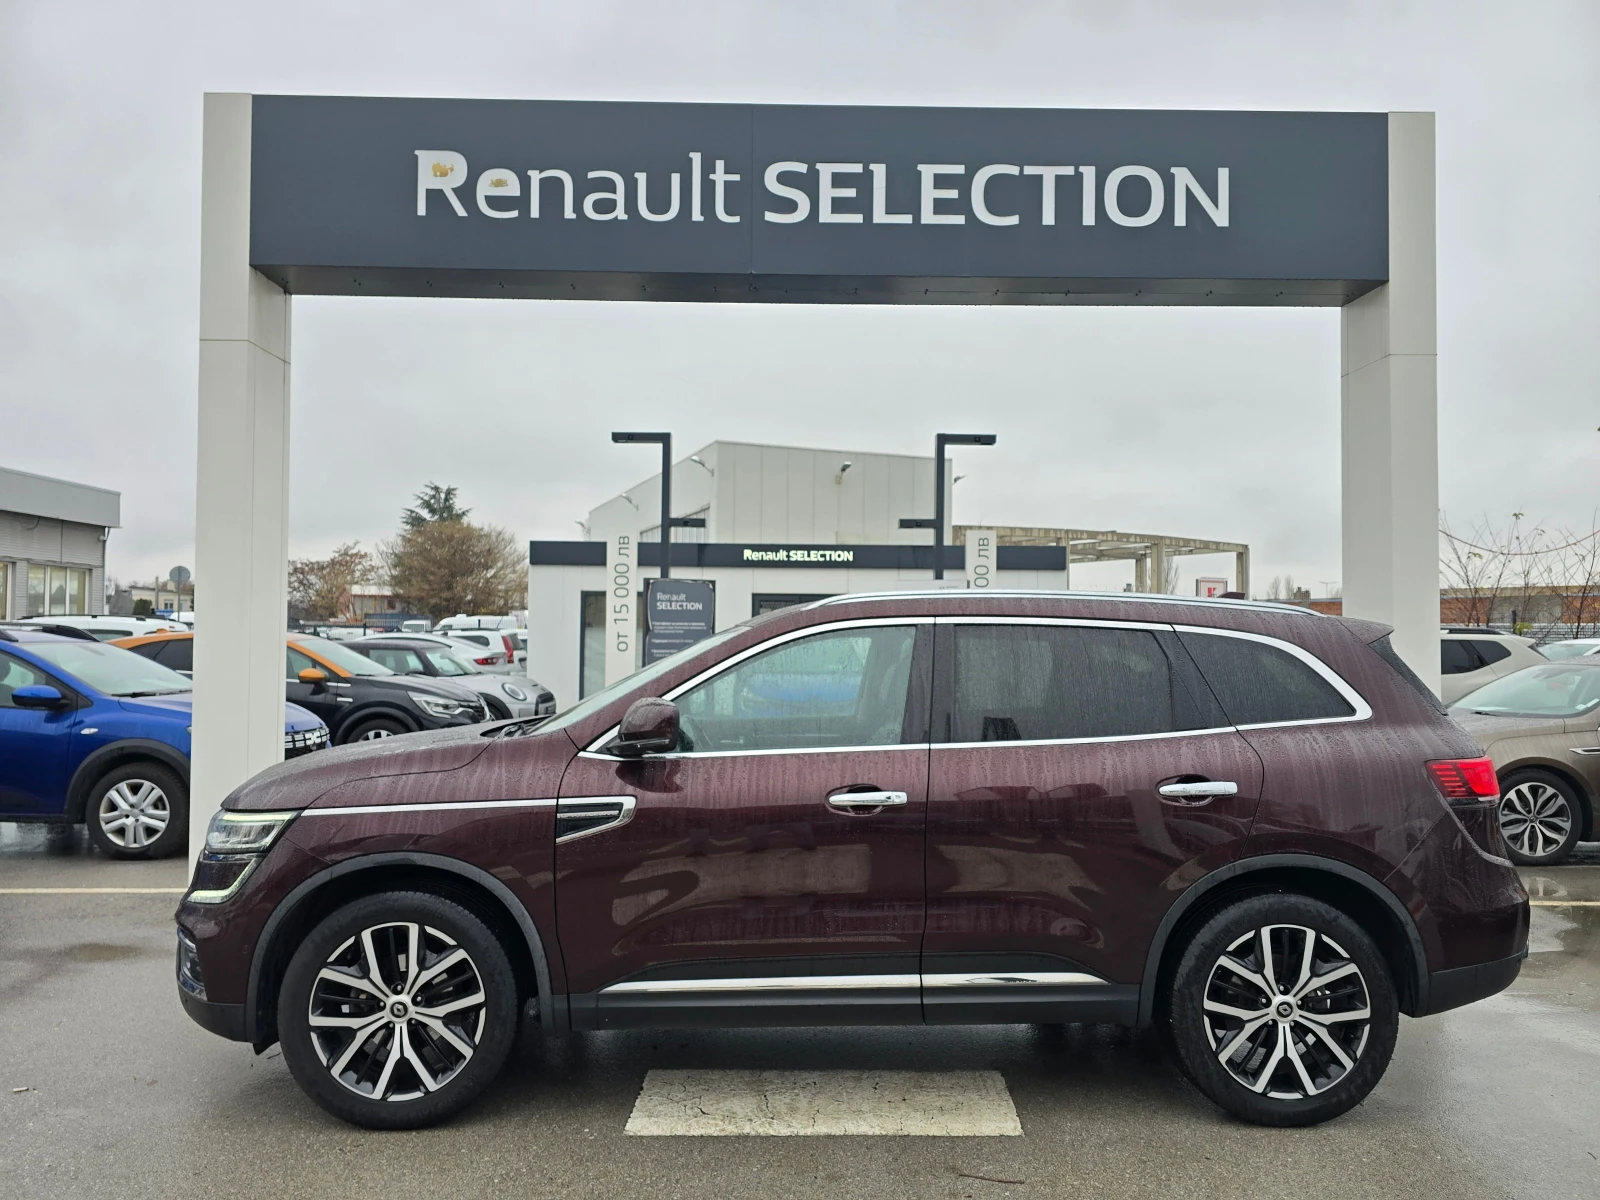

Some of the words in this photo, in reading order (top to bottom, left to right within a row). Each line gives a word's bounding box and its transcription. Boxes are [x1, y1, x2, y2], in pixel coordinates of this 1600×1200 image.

[414, 150, 740, 223] Renault
[764, 161, 1231, 227] SELECTION
[743, 549, 788, 562] Renault
[789, 550, 854, 562] SELECTION
[614, 563, 630, 598] 000
[657, 592, 686, 601] Renault
[614, 604, 629, 625] 15
[656, 602, 702, 610] SELECTION
